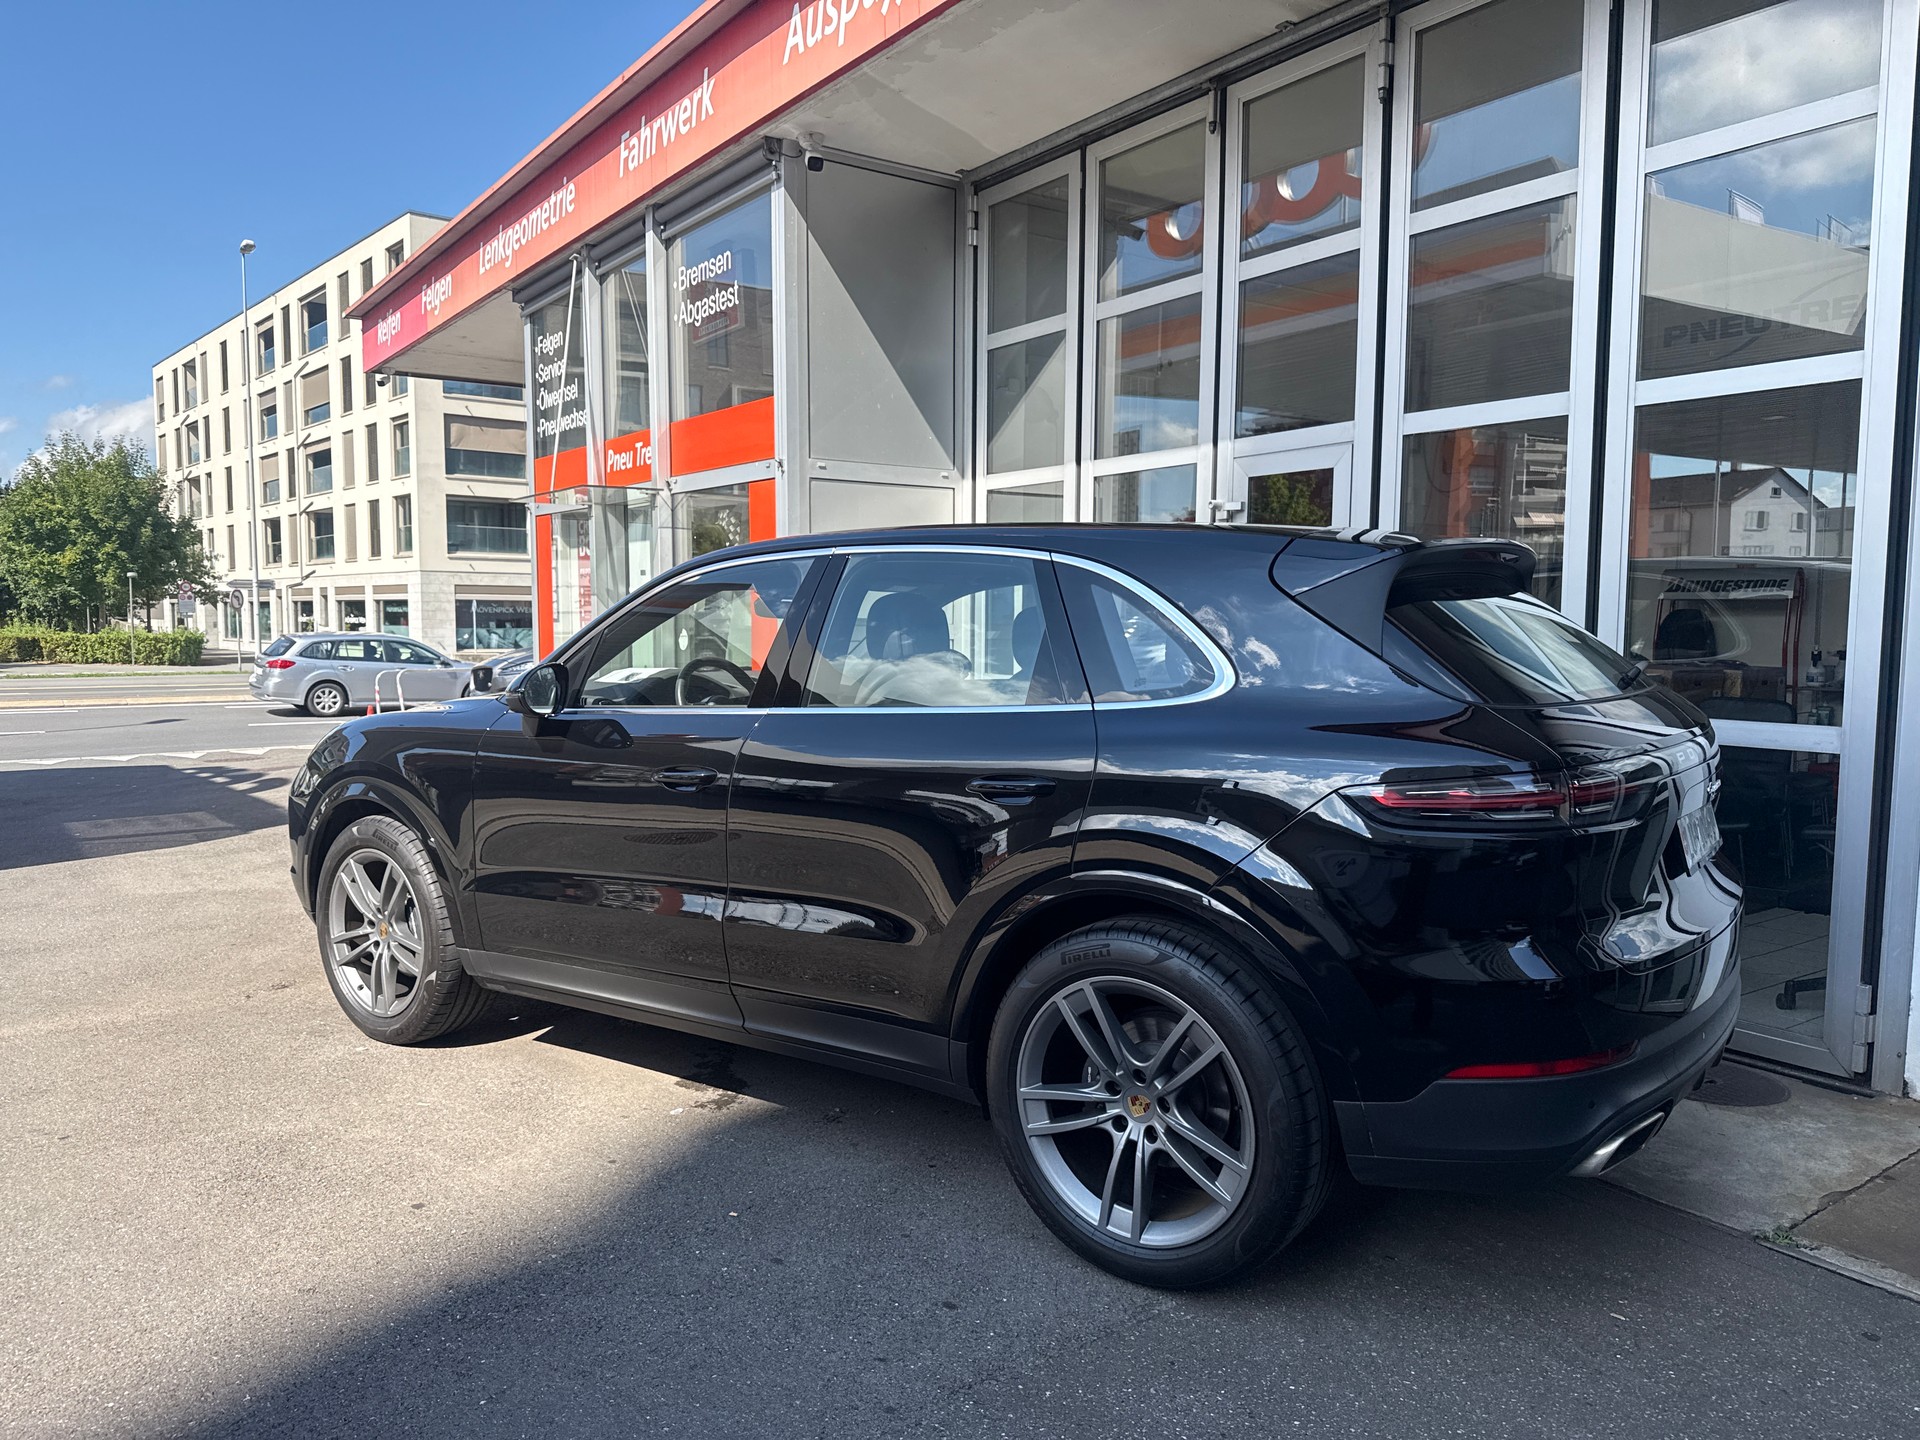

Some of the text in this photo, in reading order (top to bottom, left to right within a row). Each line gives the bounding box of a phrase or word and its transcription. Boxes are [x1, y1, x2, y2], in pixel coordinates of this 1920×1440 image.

[618, 67, 716, 178] Fahrwerk
[479, 176, 576, 275] Lenkgeometrie
[678, 250, 732, 292] Bremsen
[421, 273, 452, 316] Felgen
[678, 280, 740, 327] Abgastest
[377, 309, 401, 346] Reifen
[538, 331, 563, 356] Felgen
[607, 449, 633, 473] Pneu
[1664, 578, 1790, 593] BRIDGESTONE
[372, 828, 399, 851] PIRELLI
[1060, 943, 1111, 965] PIRELLI
